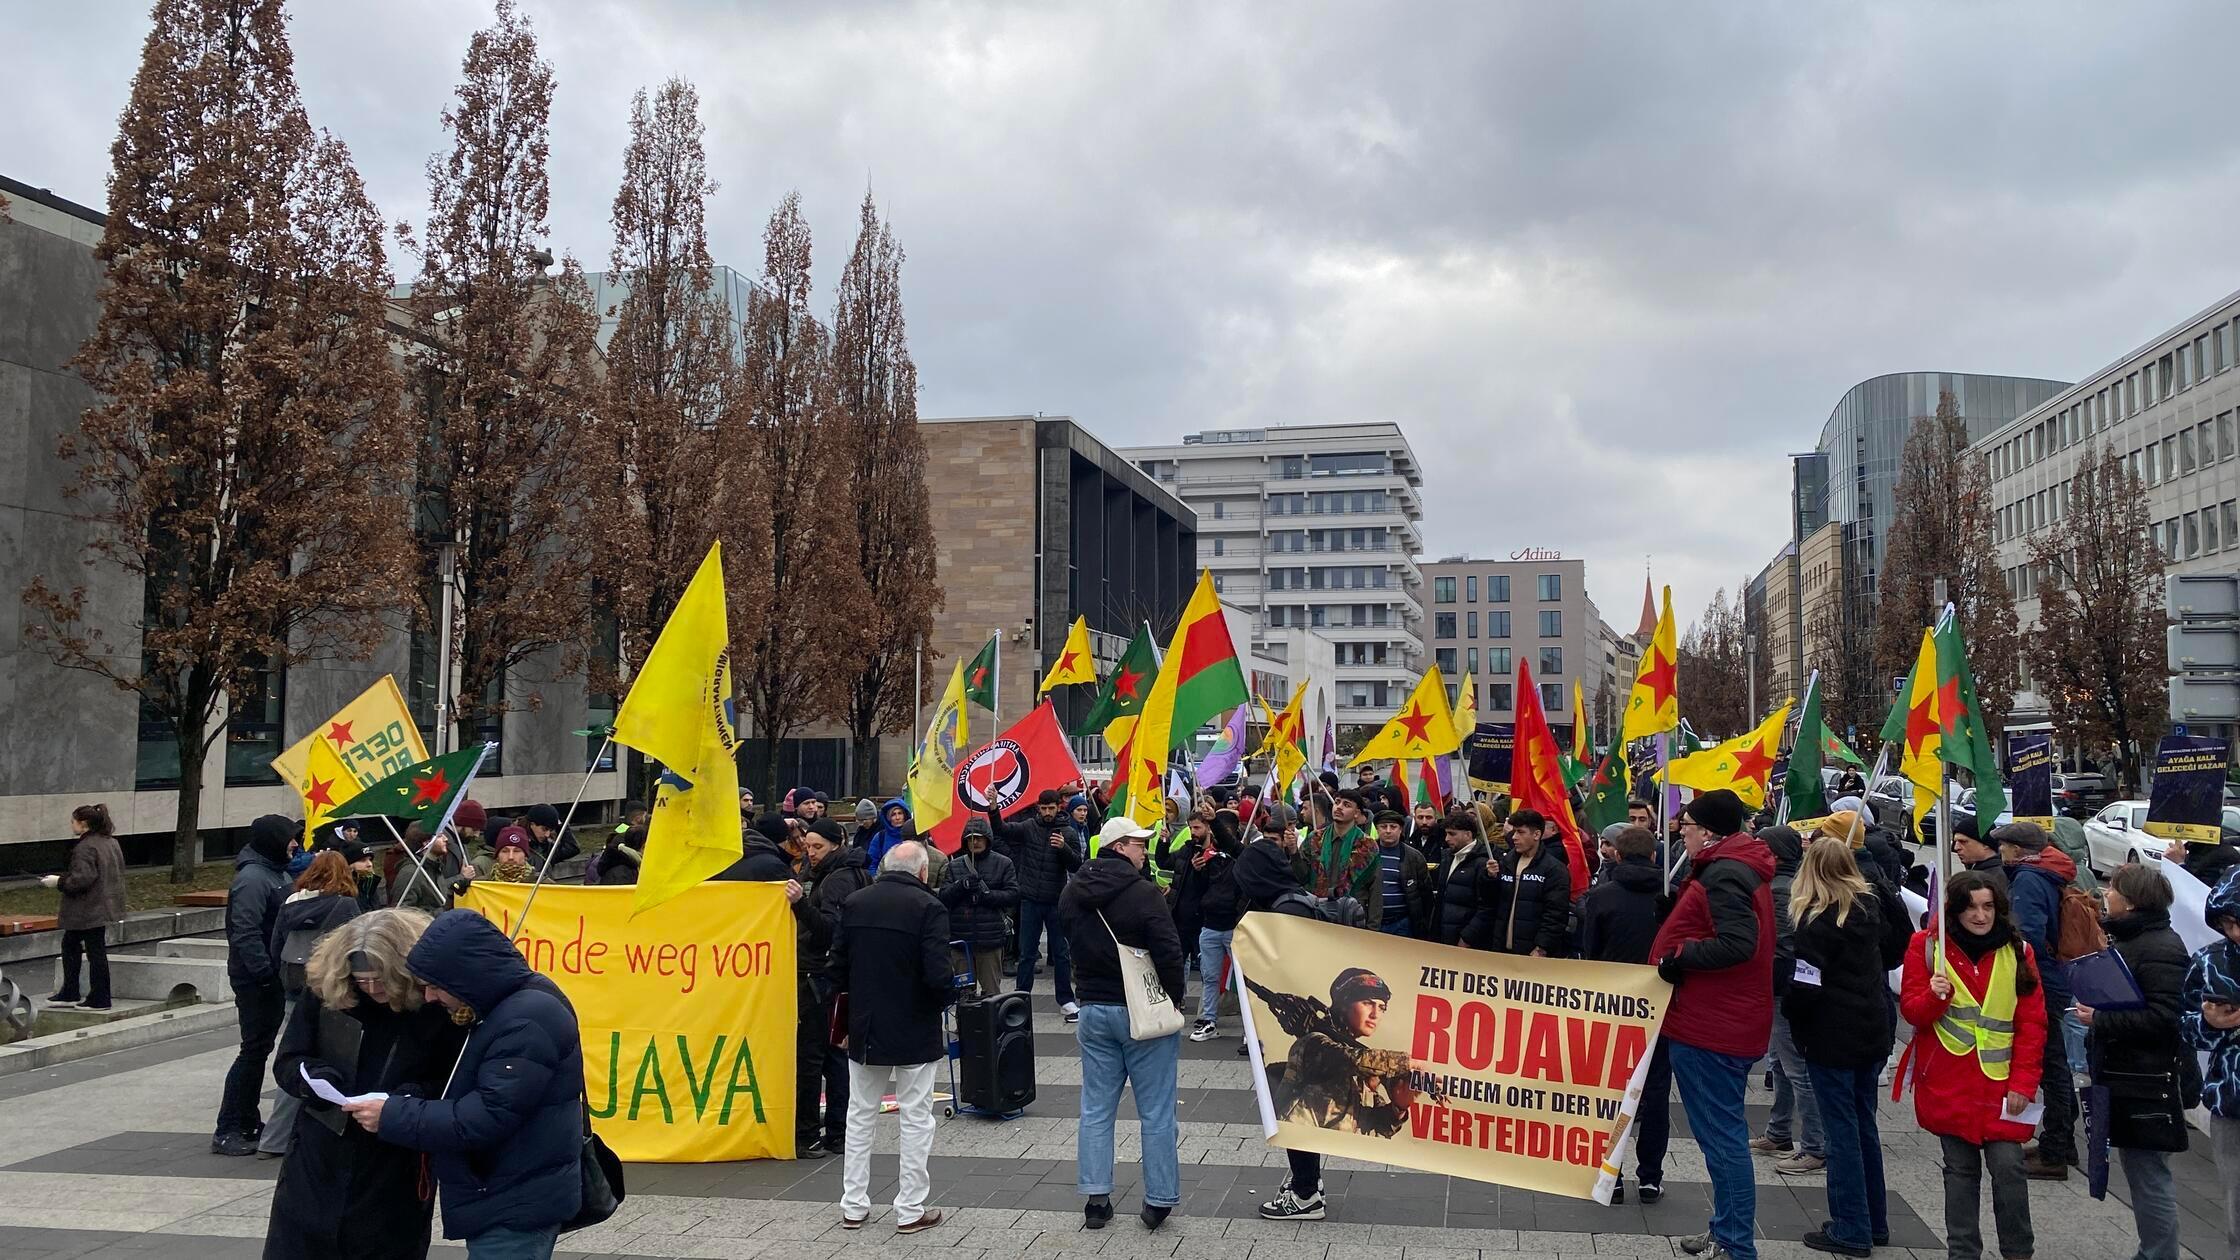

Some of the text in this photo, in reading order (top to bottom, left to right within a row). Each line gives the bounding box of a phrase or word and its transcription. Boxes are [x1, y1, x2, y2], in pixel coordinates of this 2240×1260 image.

[1510, 547, 1561, 560] Adina
[2175, 726, 2183, 735] P
[625, 943, 697, 993] weg
[712, 941, 771, 978] von
[1419, 966, 1656, 1020] ZEIT DES WIDERSTANDS:
[1411, 994, 1649, 1092] ROJAVA
[587, 1031, 767, 1125] JAVA
[1410, 1071, 1436, 1094] AN
[1441, 1074, 1501, 1105] JEDEM
[1506, 1086, 1546, 1110] ORT
[1551, 1092, 1589, 1117] DER
[1408, 1102, 1611, 1169] VERTEIDIGE
